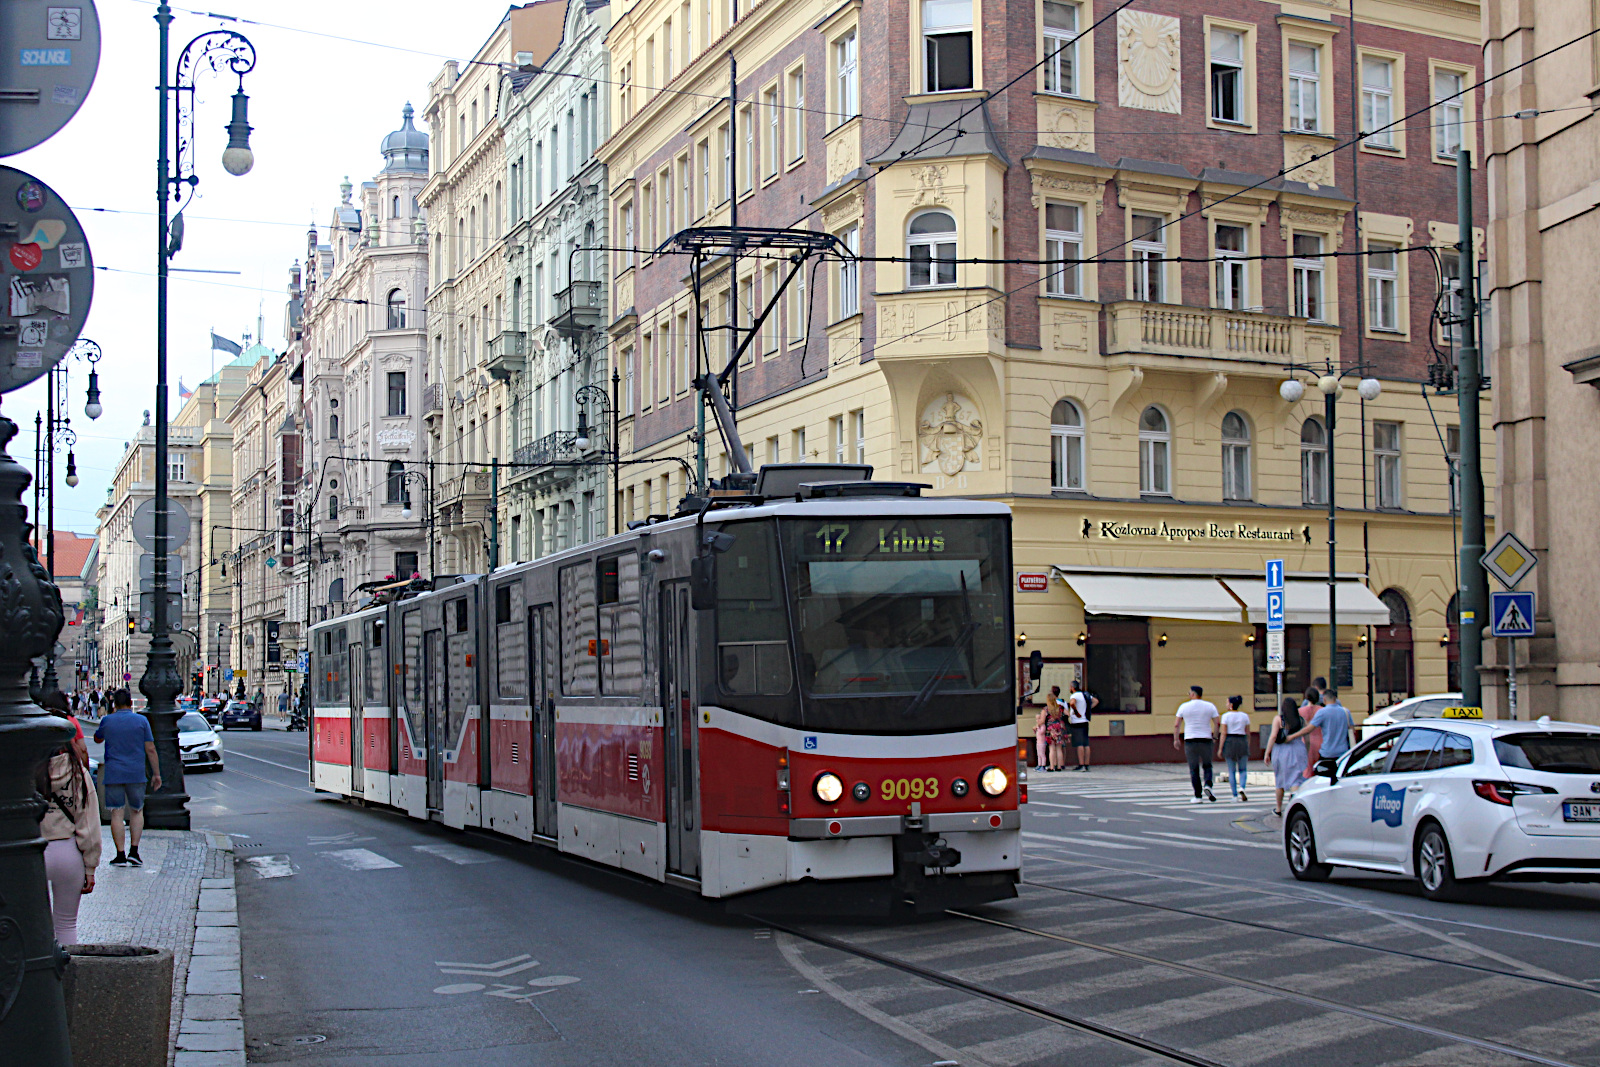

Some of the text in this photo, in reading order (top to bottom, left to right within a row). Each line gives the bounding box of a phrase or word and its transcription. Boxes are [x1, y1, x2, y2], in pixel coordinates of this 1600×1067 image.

[816, 524, 945, 554] 17 Libuš
[1101, 521, 1294, 541] Kozlovna Apropos Beer Restaurant
[1451, 707, 1479, 717] TAXI
[881, 777, 939, 801] 9093
[1375, 794, 1401, 815] Liftago
